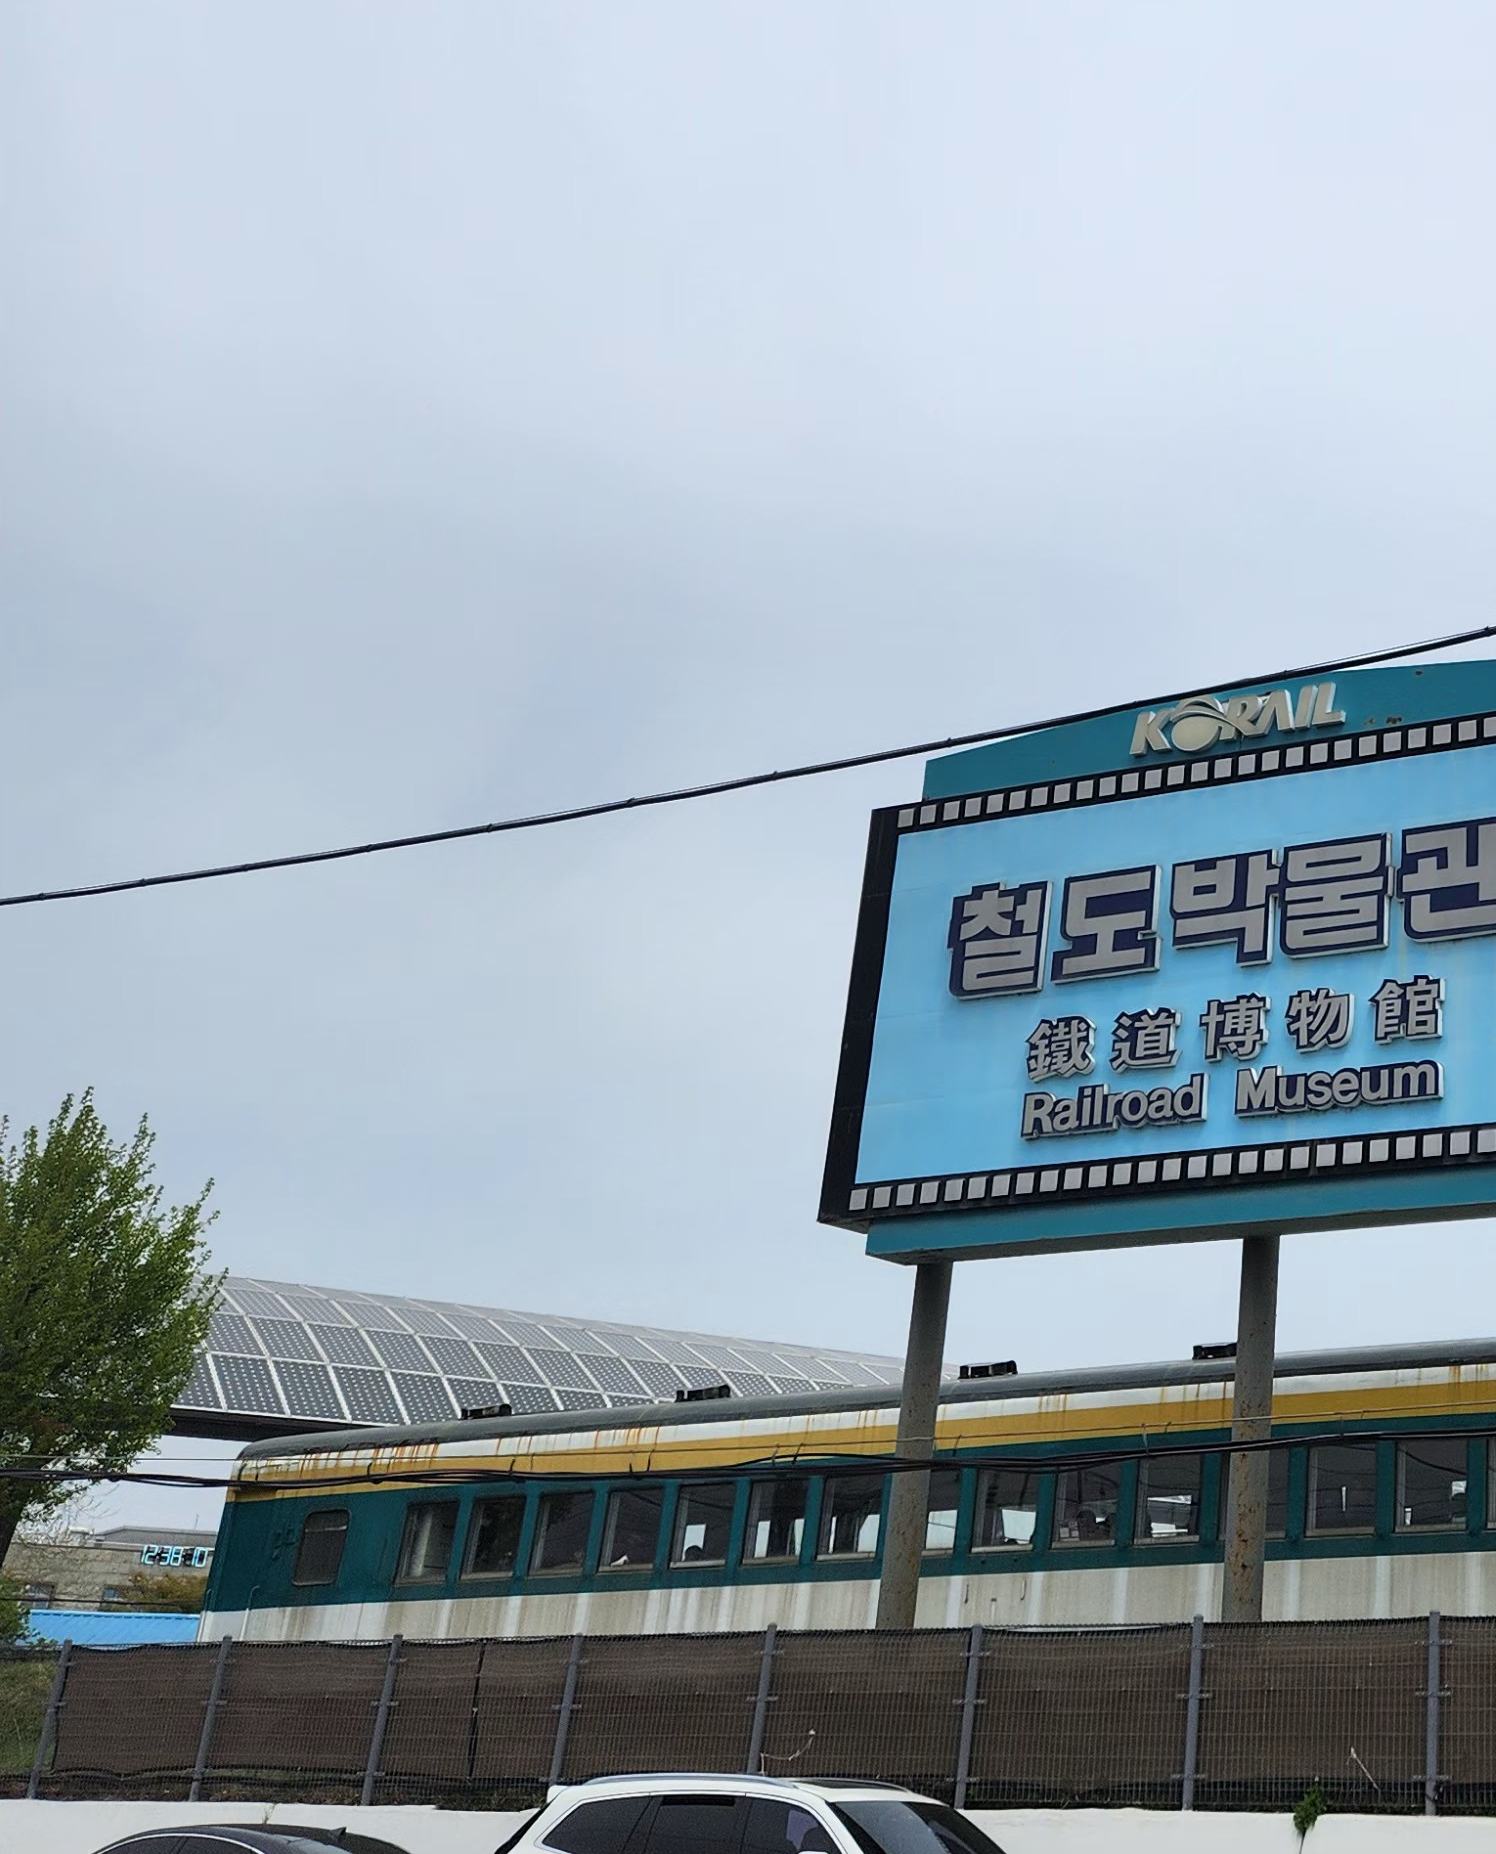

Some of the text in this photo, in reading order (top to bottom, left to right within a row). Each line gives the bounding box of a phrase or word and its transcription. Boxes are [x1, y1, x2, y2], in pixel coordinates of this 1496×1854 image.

[1129, 681, 1346, 756] KORAIL
[1026, 975, 1445, 1082] 鐵道博物館
[1021, 1060, 1444, 1140] Railroad Museum
